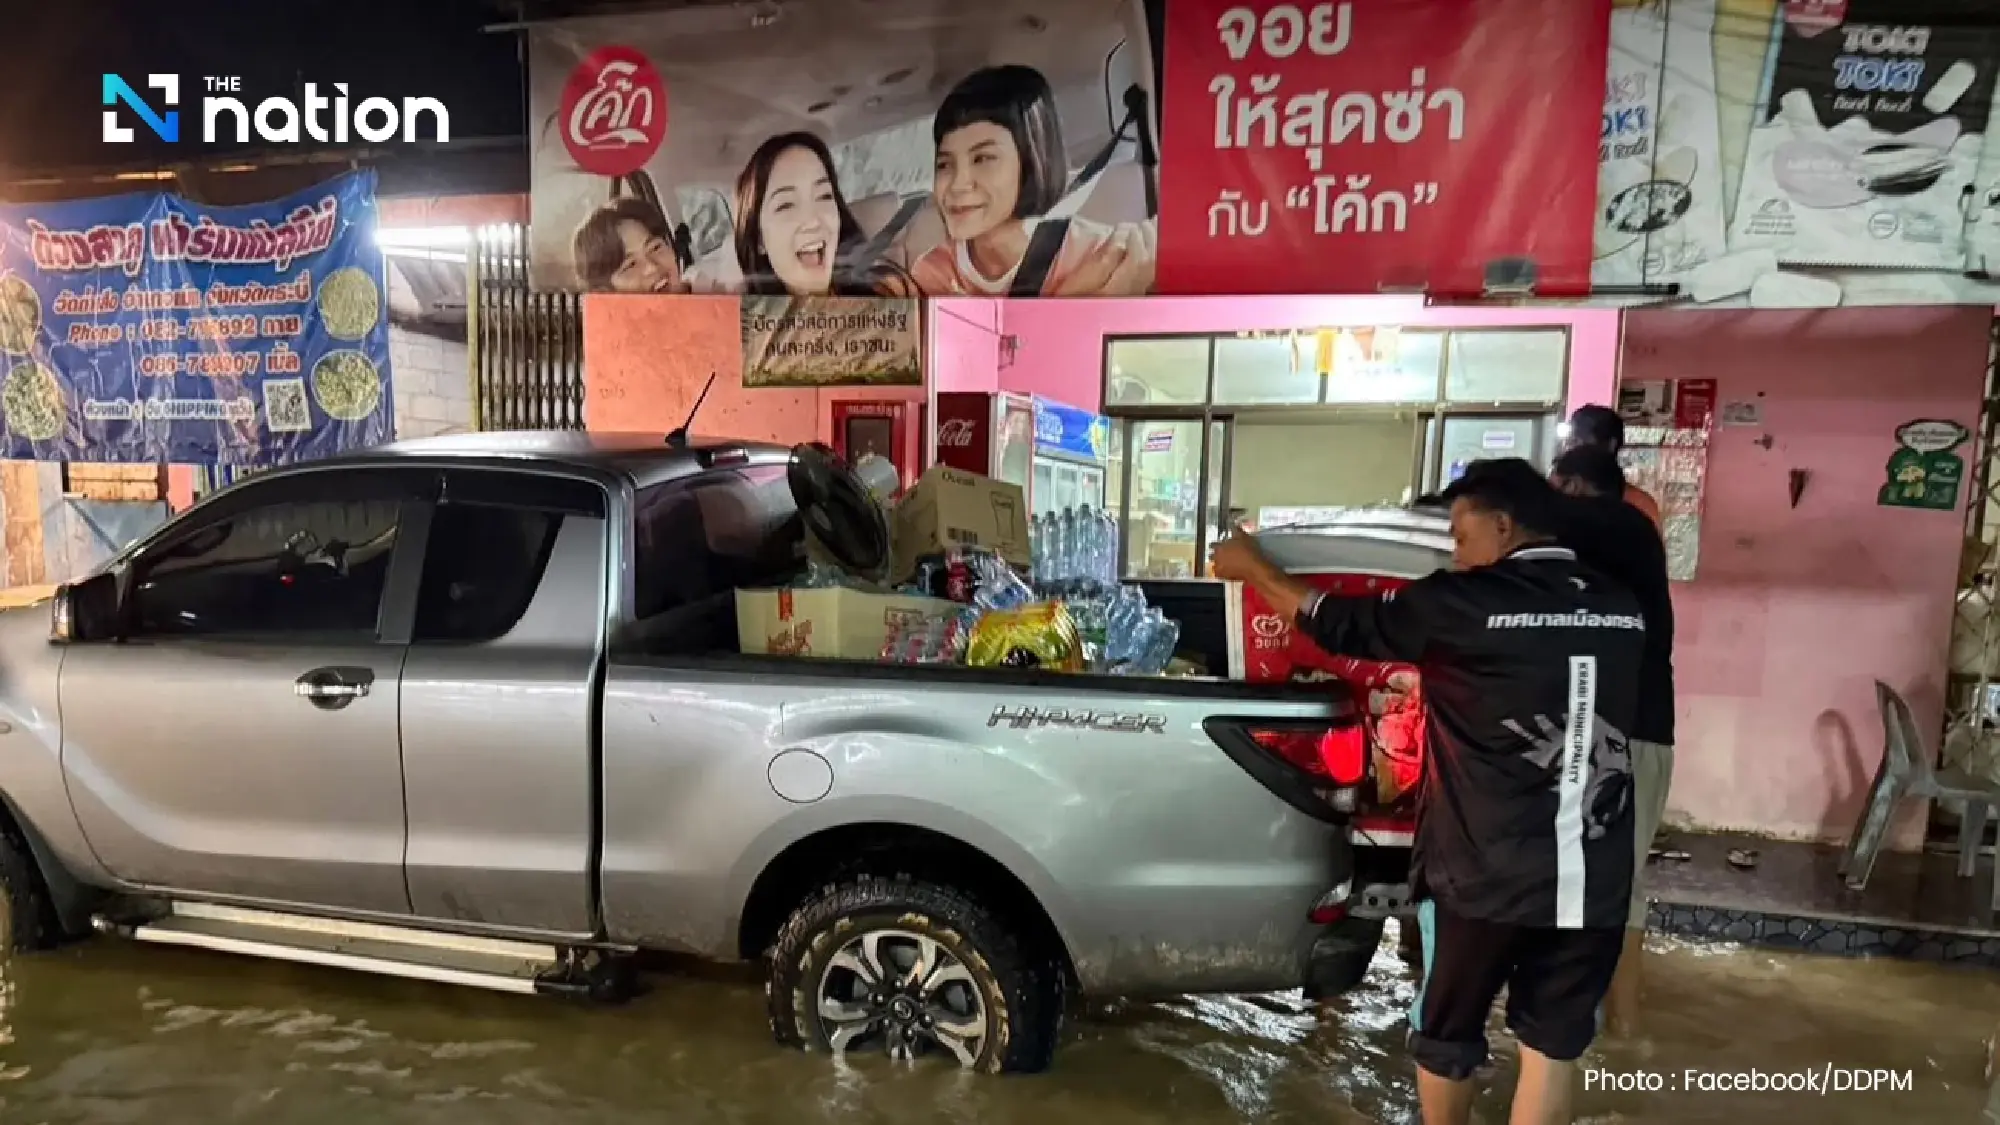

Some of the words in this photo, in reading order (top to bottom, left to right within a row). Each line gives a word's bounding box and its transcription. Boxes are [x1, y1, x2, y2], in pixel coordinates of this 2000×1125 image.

[1216, 1, 1353, 60] จอย
[1833, 55, 1926, 92] TOKI
[1208, 67, 1466, 171] ให้สุดซ่า
[1208, 188, 1269, 238] กับ
